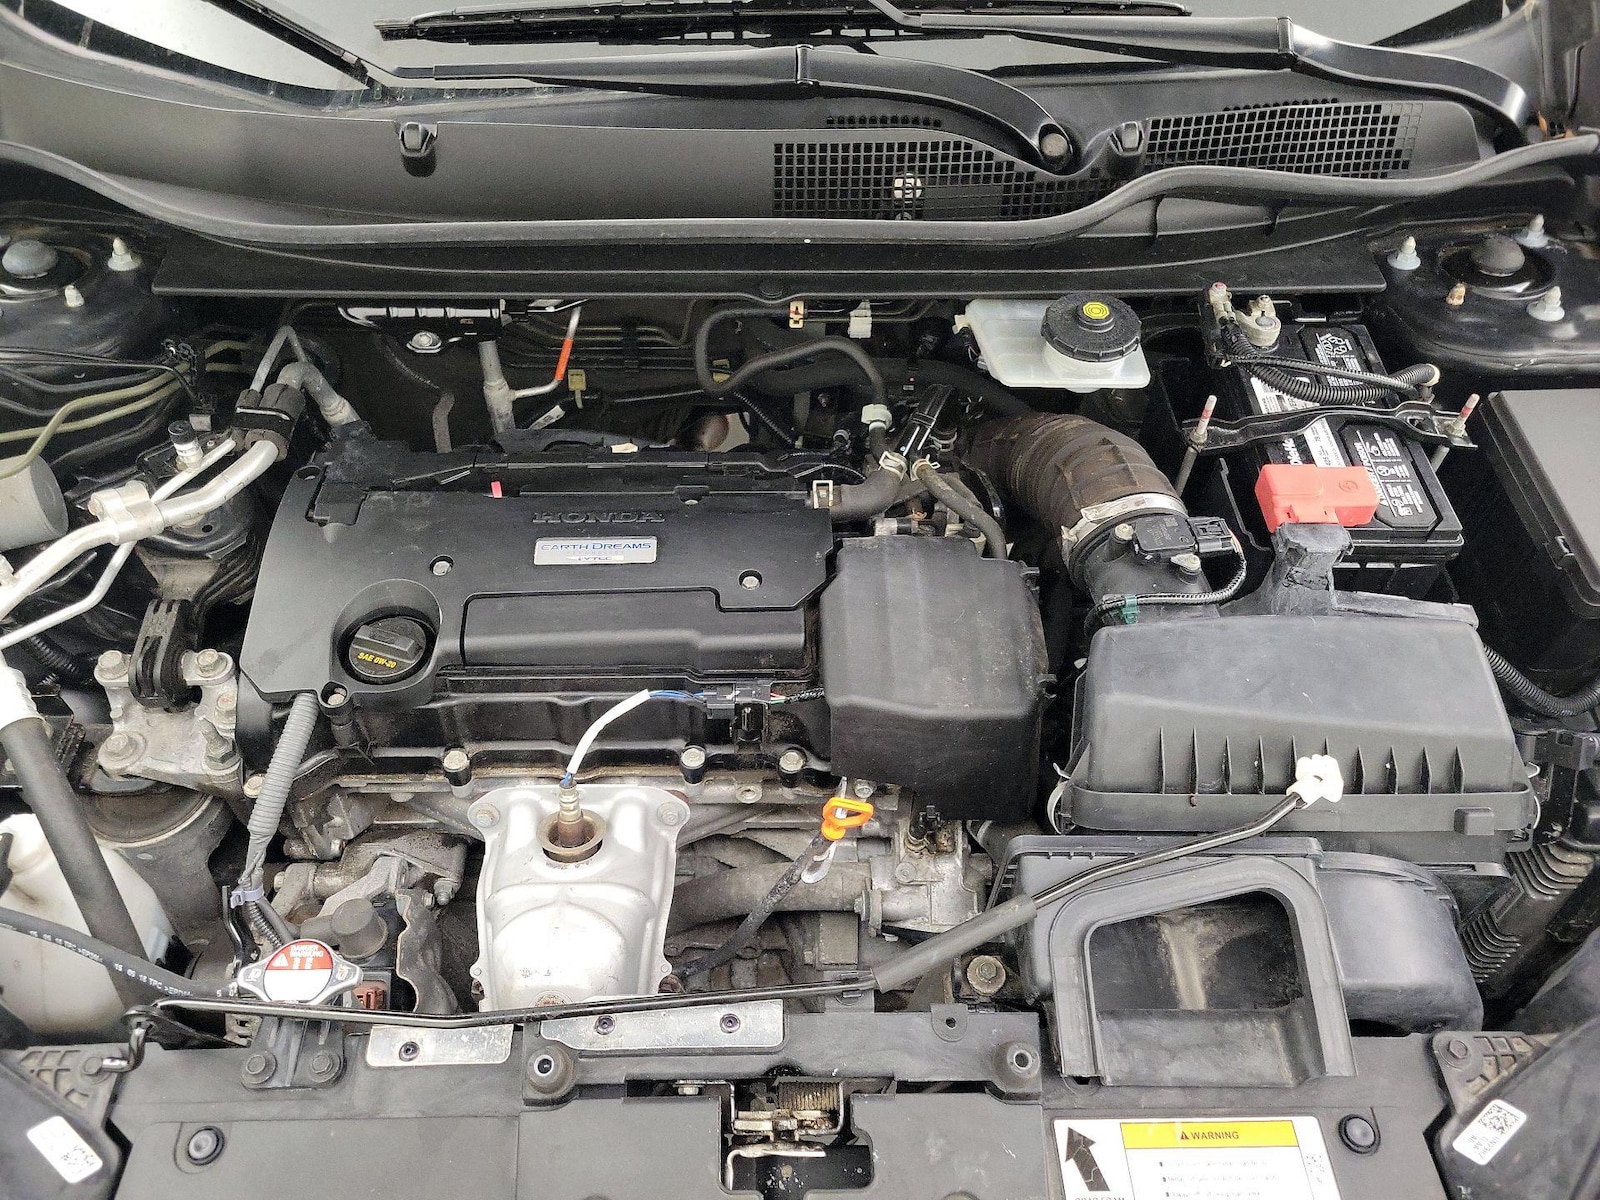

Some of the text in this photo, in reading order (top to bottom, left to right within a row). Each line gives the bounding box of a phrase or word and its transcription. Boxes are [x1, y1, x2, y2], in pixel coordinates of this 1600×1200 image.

[532, 512, 666, 523] HONDA
[357, 652, 397, 668] SAE 0W-20
[148, 977, 163, 990] TPC
[1190, 1131, 1240, 1140] WARNING
